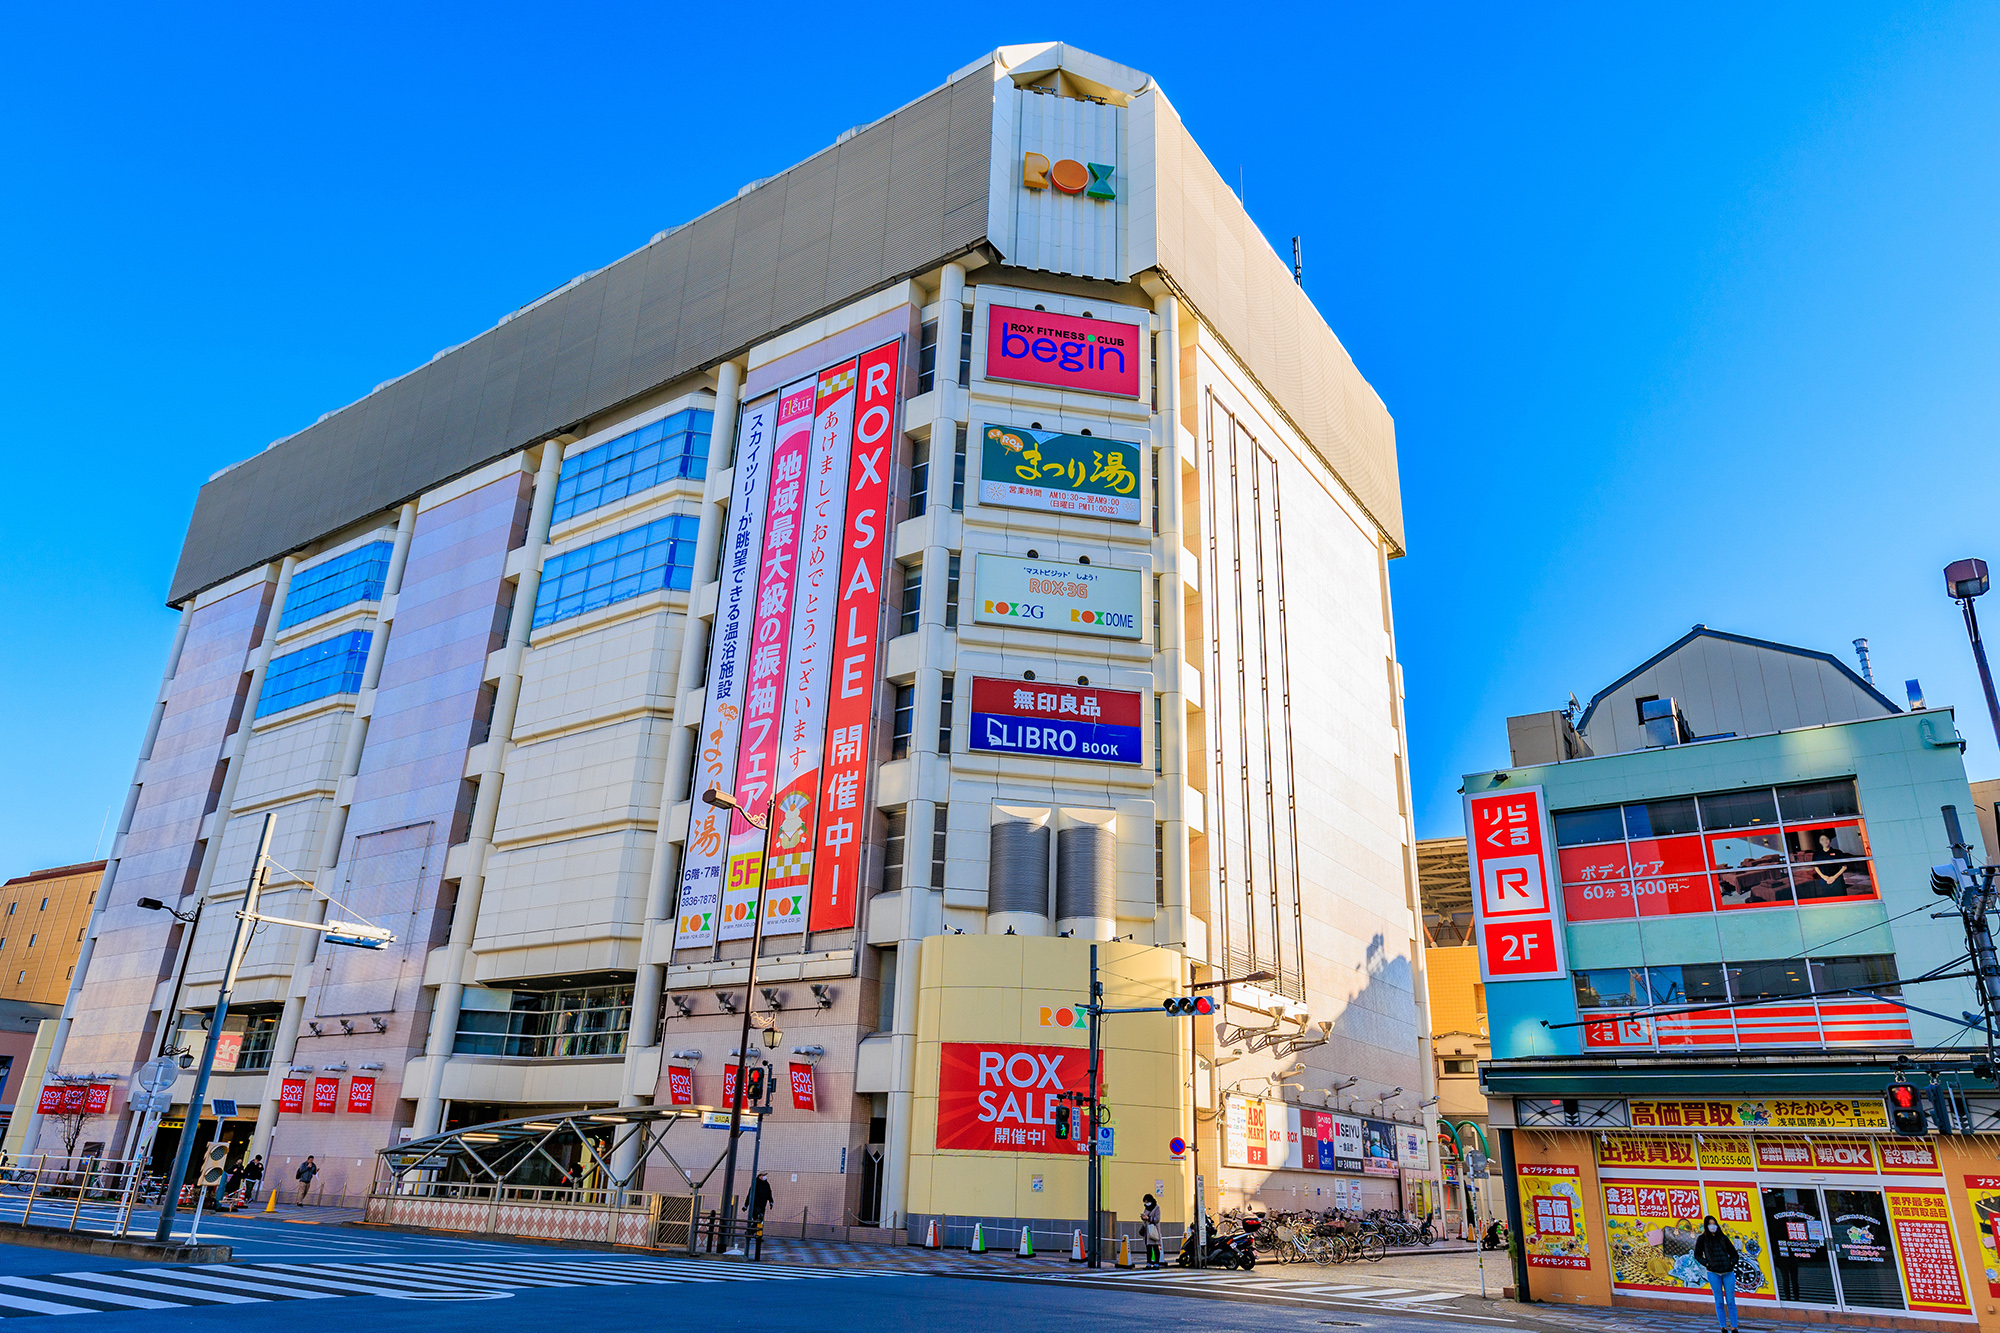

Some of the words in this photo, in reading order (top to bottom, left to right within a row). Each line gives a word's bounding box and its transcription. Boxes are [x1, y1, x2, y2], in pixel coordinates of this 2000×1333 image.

[1024, 151, 1116, 200] ROX
[1010, 323, 1034, 334] ROX
[1037, 326, 1085, 341] FITNESS
[1097, 335, 1125, 347] CLUB
[1001, 322, 1125, 374] begin
[855, 362, 890, 491] ROX
[1002, 435, 1023, 451] ROX
[1016, 442, 1136, 494] まつり湯
[1009, 486, 1042, 498] 営業時間
[716, 414, 764, 700] スカイツリーが眺望できる温浴施設
[790, 411, 839, 772] あけましておめでとうございます
[840, 508, 876, 700] SALE
[984, 600, 1019, 616] ROX
[1022, 604, 1044, 619] 2G
[1070, 608, 1105, 625] ROX
[1106, 612, 1134, 628] DOME
[740, 450, 802, 813] 地域最大級の振袖フェア
[1013, 688, 1100, 717] 無印良品
[1002, 724, 1077, 752] LIBRO
[1082, 742, 1118, 756] BOOK
[730, 858, 760, 888] 5F
[1581, 860, 1664, 880] ボディケア
[1496, 867, 1530, 900] R
[1584, 885, 1616, 900] 60分
[681, 894, 717, 907] 3836-7878
[768, 896, 802, 918] ROX
[724, 900, 756, 922] ROX
[680, 912, 712, 934] ROX
[680, 932, 710, 940] www.rox.co.jp
[1501, 933, 1538, 962] 2F
[1038, 1006, 1089, 1030] ROX
[978, 1051, 1064, 1090] ROX
[670, 1074, 690, 1085] ROX
[792, 1072, 812, 1084] ROX
[43, 1090, 62, 1098] ROX
[89, 1088, 108, 1098] ROX
[283, 1084, 302, 1094] ROX
[316, 1084, 336, 1093] ROX
[352, 1082, 372, 1092] ROX
[673, 1084, 691, 1096] SALE
[794, 1083, 812, 1094] SALE
[88, 1096, 106, 1104] SALE
[282, 1093, 302, 1102] SALE
[316, 1092, 336, 1102] SALE
[351, 1092, 372, 1101] SALE
[978, 1090, 1059, 1126] SALE
[1630, 1102, 1736, 1126] 高価買取
[1774, 1101, 1849, 1116] おたからや
[1248, 1107, 1264, 1127] ABC
[1778, 1118, 1887, 1128] 浅草国際通り一丁目本店
[1248, 1127, 1264, 1141] MART
[1269, 1130, 1282, 1142] ROX
[1287, 1131, 1298, 1143] ROX
[1340, 1124, 1360, 1138] SEIYU
[1600, 1140, 1694, 1163] 出張買取
[1700, 1142, 1749, 1153] 無料通話
[1252, 1150, 1262, 1160] 3F
[1784, 1148, 1809, 1162] 無料
[1834, 1149, 1870, 1164] OK
[1902, 1150, 1934, 1164] 現金
[1606, 1188, 1620, 1202] 金
[1638, 1188, 1666, 1204] ダイヤ
[1670, 1190, 1698, 1204] ブランド
[1718, 1192, 1747, 1206] ブランド
[1890, 1196, 1944, 1207] 業界最多級
[1536, 1200, 1568, 1216] 高価
[1608, 1204, 1636, 1216] 貴金属
[1673, 1204, 1700, 1218] バッグ
[1720, 1206, 1748, 1220] 時計
[1892, 1206, 1947, 1218] 高価買取品目
[1538, 1216, 1571, 1234] 買取
